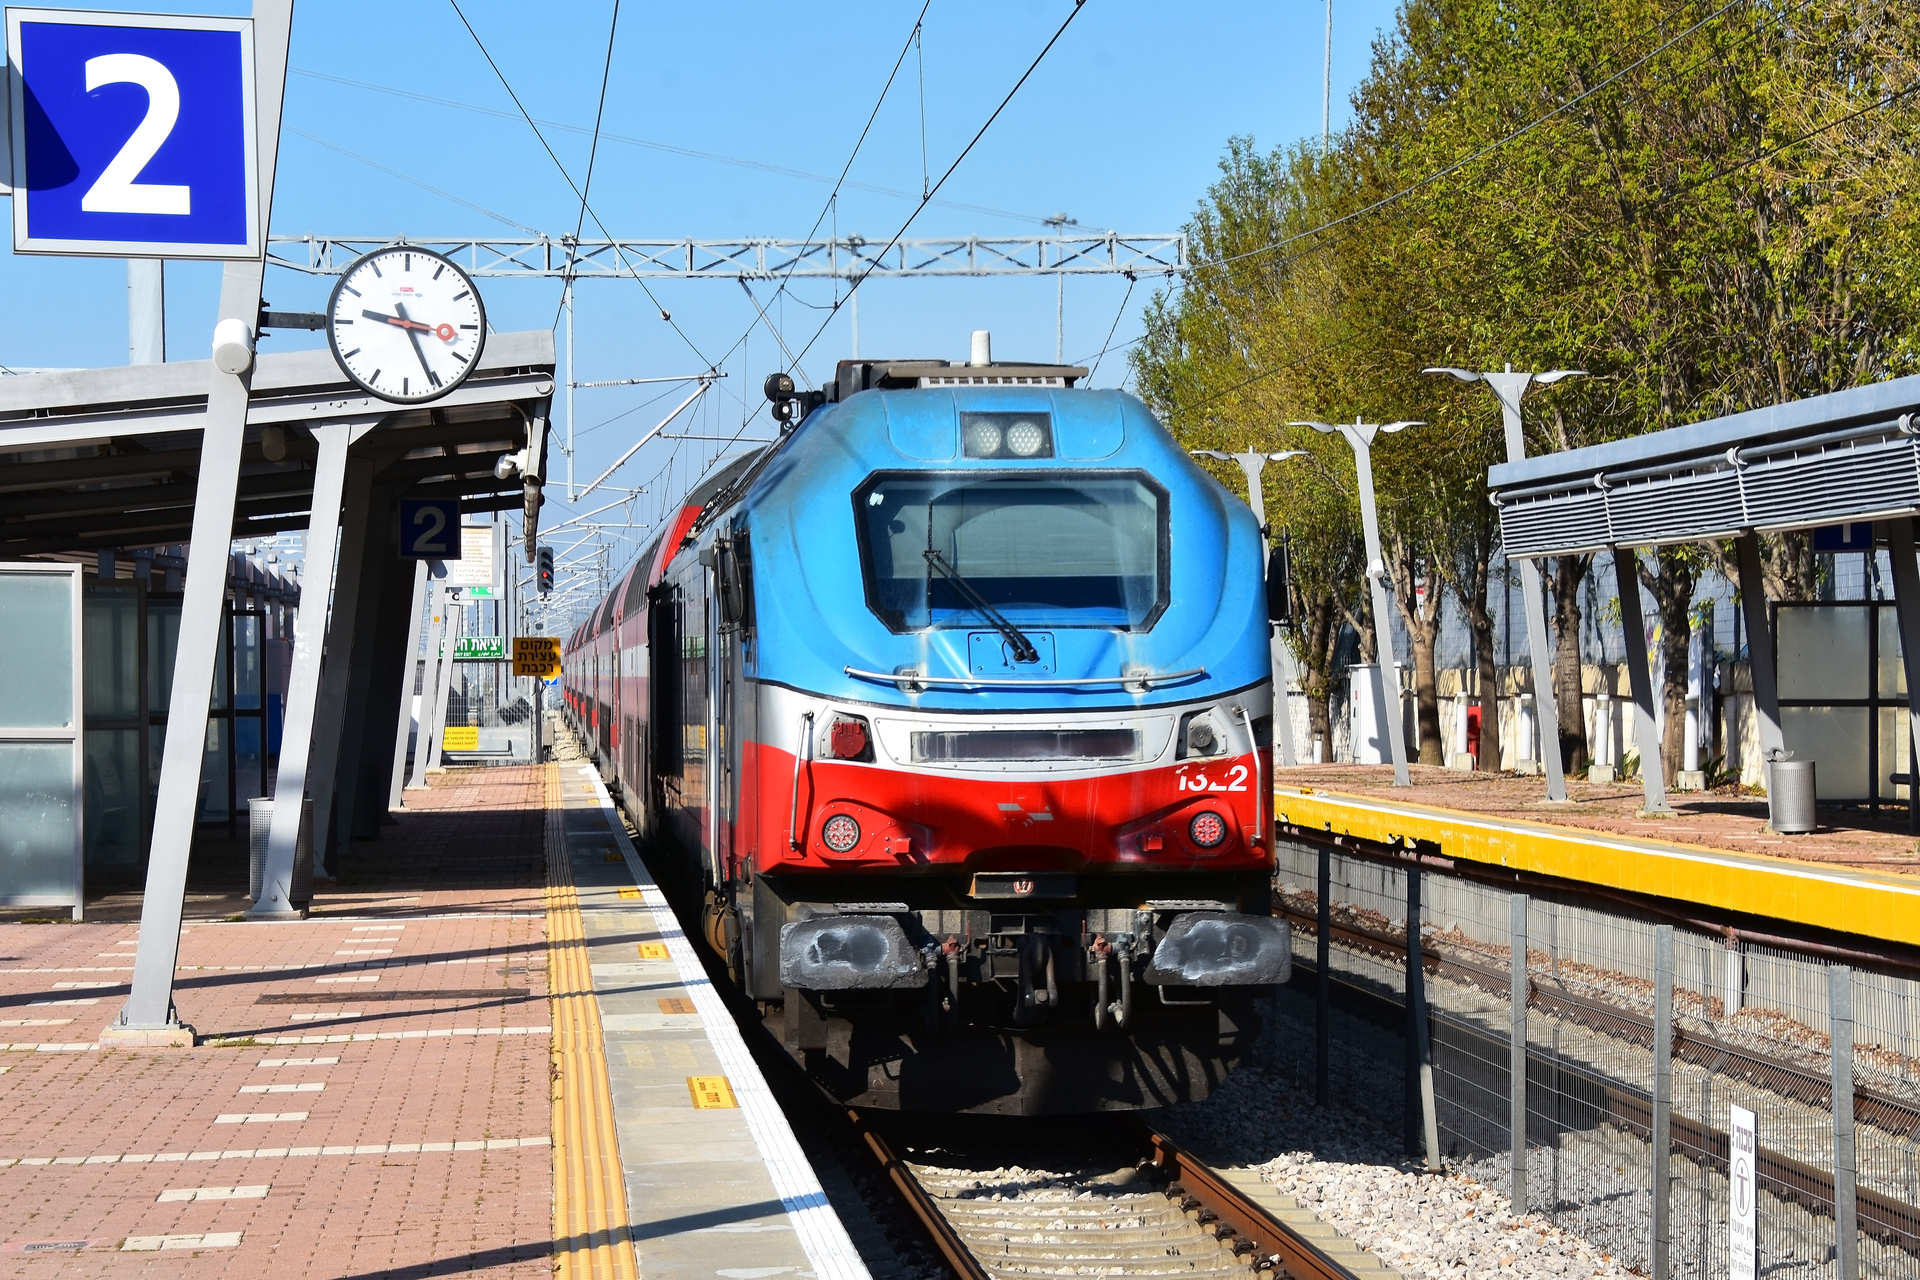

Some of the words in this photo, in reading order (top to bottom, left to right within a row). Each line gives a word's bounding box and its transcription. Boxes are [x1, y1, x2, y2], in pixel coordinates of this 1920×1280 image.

[82, 53, 190, 215] 2
[413, 506, 446, 552] 2
[471, 638, 501, 651] יציאת
[520, 640, 553, 652] מקום
[517, 652, 557, 662] עצירת
[520, 663, 554, 673] רכבת
[1731, 1258, 1738, 1270] NO
[1738, 1261, 1754, 1278] ENTRY
